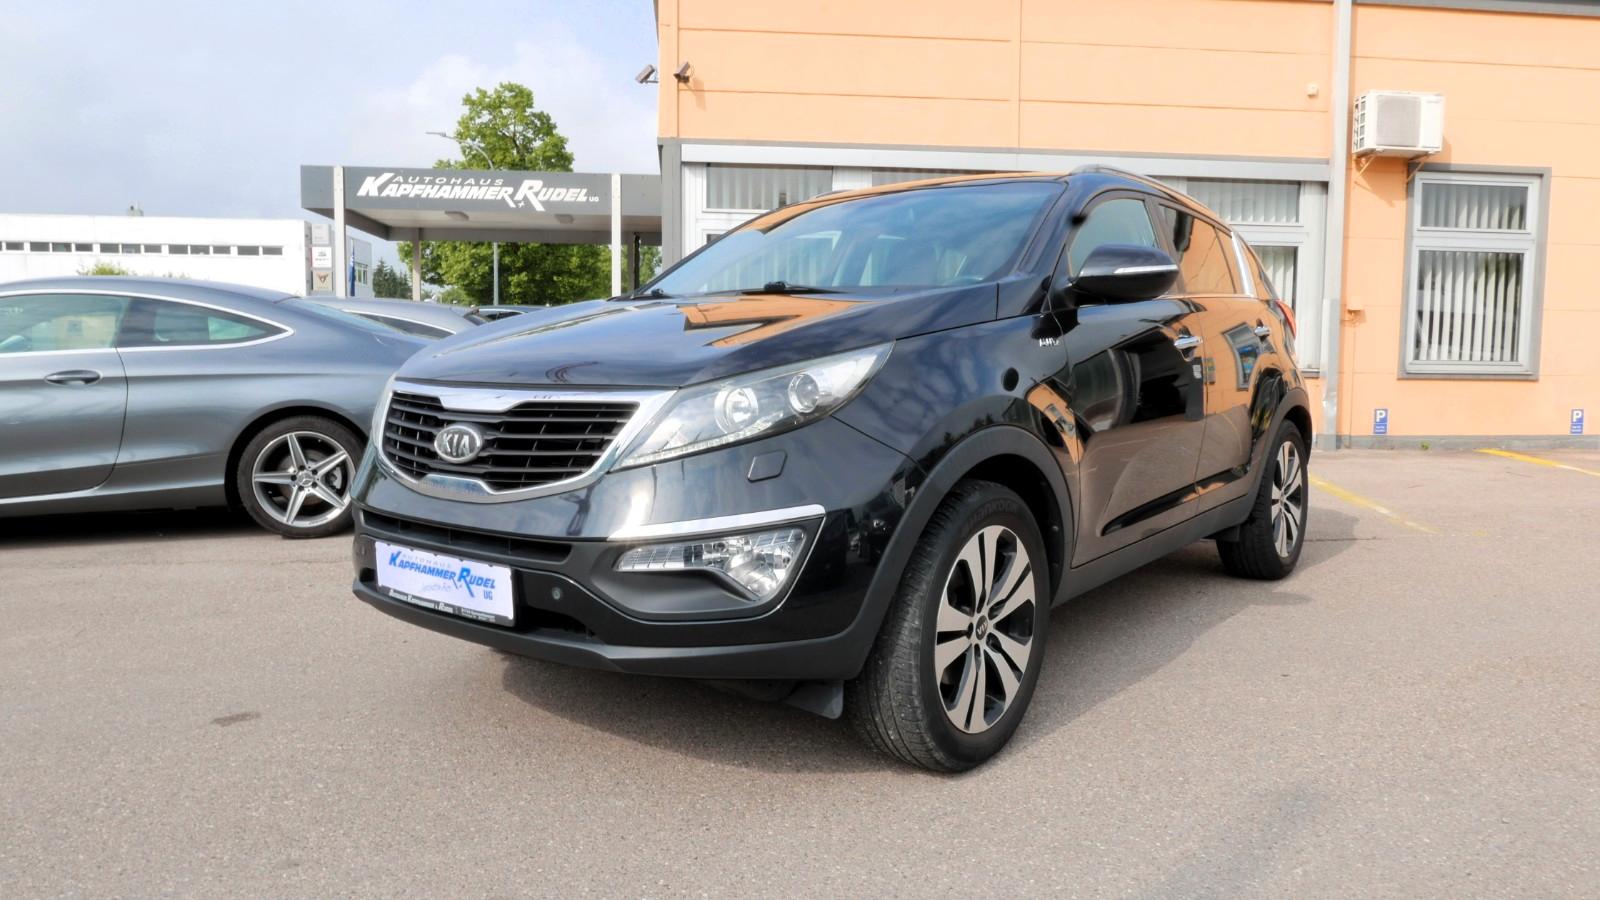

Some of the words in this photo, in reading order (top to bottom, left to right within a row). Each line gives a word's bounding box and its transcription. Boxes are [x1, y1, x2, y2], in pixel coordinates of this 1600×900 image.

[392, 175, 504, 186] AUTOHAUS
[356, 172, 517, 208] KAPFHAMMER
[513, 179, 588, 212] RUDEL
[1376, 410, 1386, 422] P
[1572, 410, 1582, 422] P
[389, 551, 459, 589] KAPFHAMMER
[458, 567, 496, 598] RUDEL
[483, 590, 493, 601] UG
